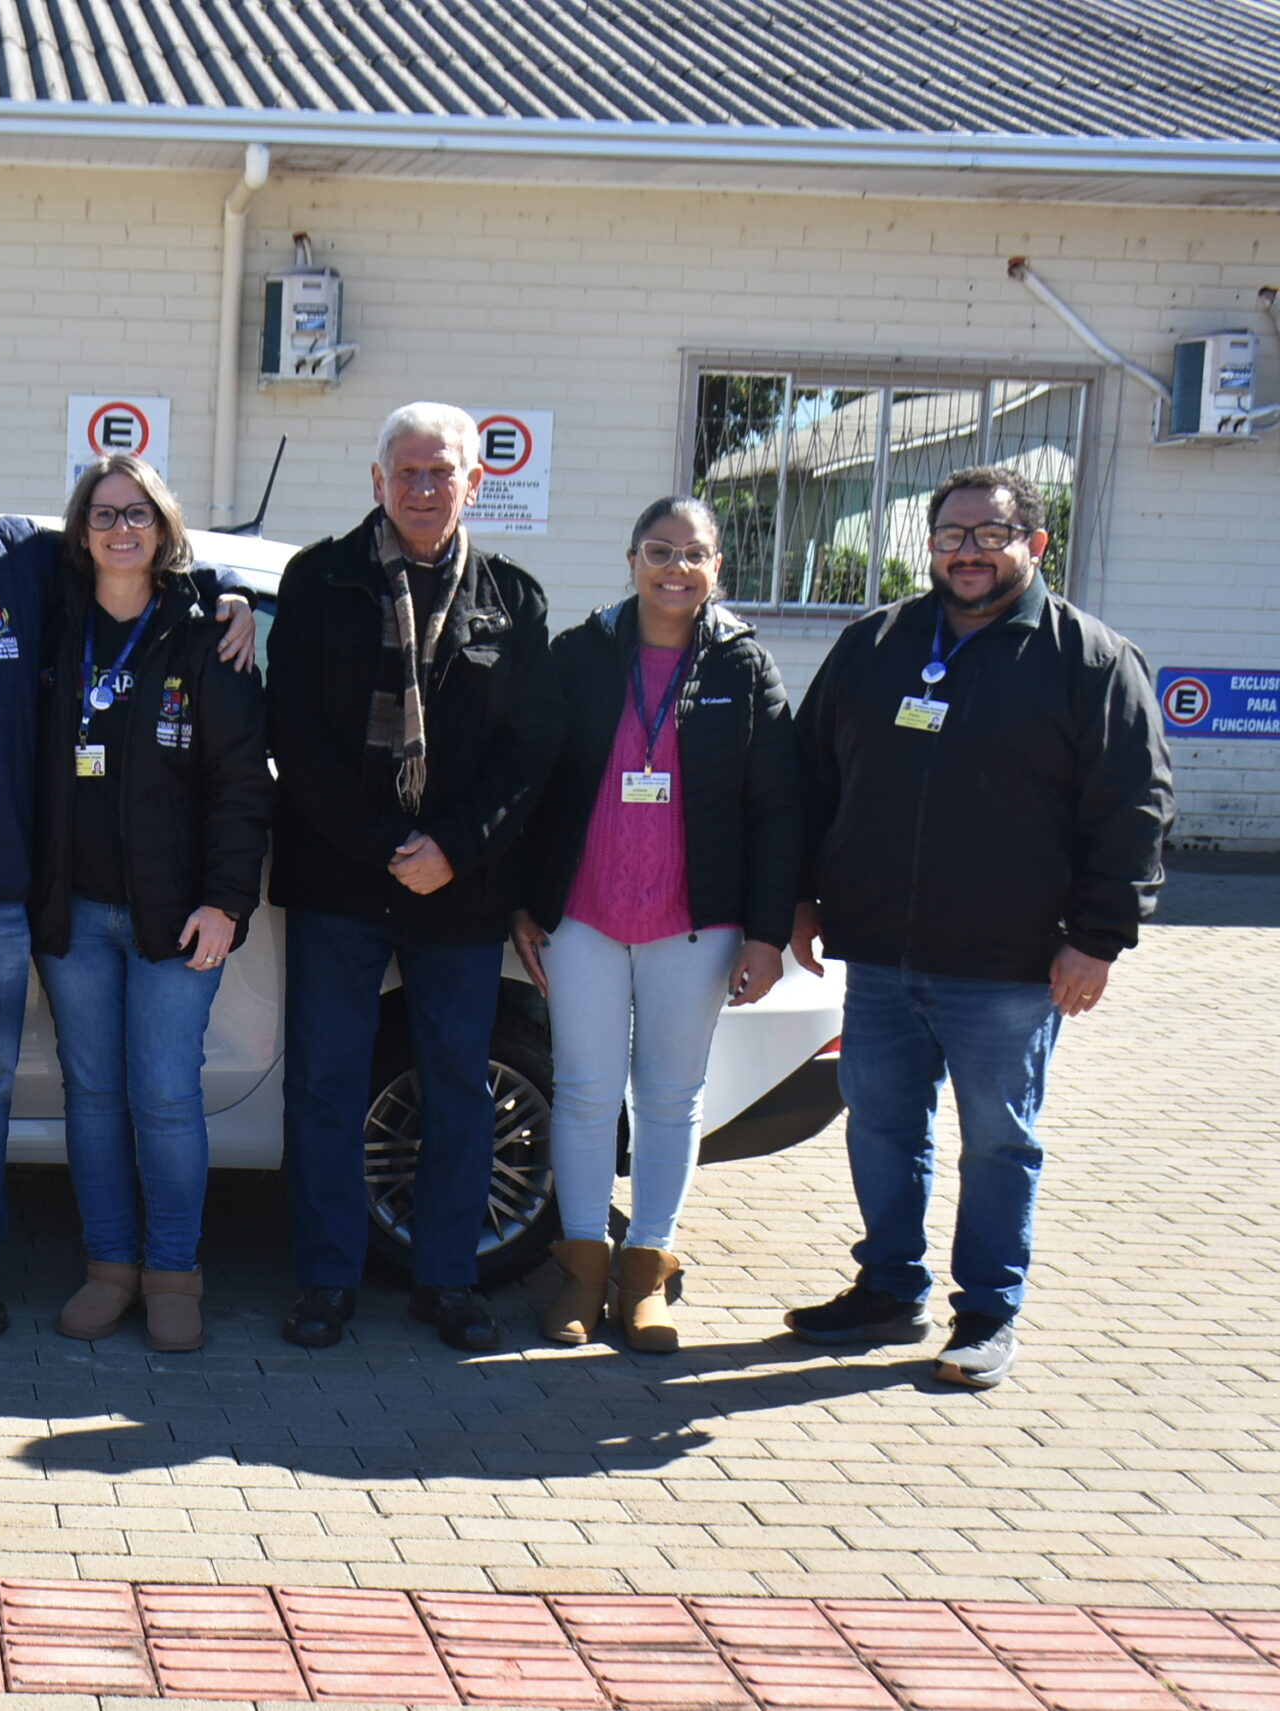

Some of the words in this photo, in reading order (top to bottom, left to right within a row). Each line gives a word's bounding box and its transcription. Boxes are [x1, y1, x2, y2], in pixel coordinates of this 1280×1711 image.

[102, 416, 133, 447] E
[485, 428, 516, 460] E
[483, 480, 540, 488] EXCLUSIVO
[483, 492, 514, 500] IDOSO
[472, 502, 528, 511] BRIGATÓRIO
[497, 510, 532, 519] CARTÃO
[1231, 676, 1280, 690] EXCLUSI
[1175, 689, 1197, 714] E
[1247, 698, 1277, 712] PARA
